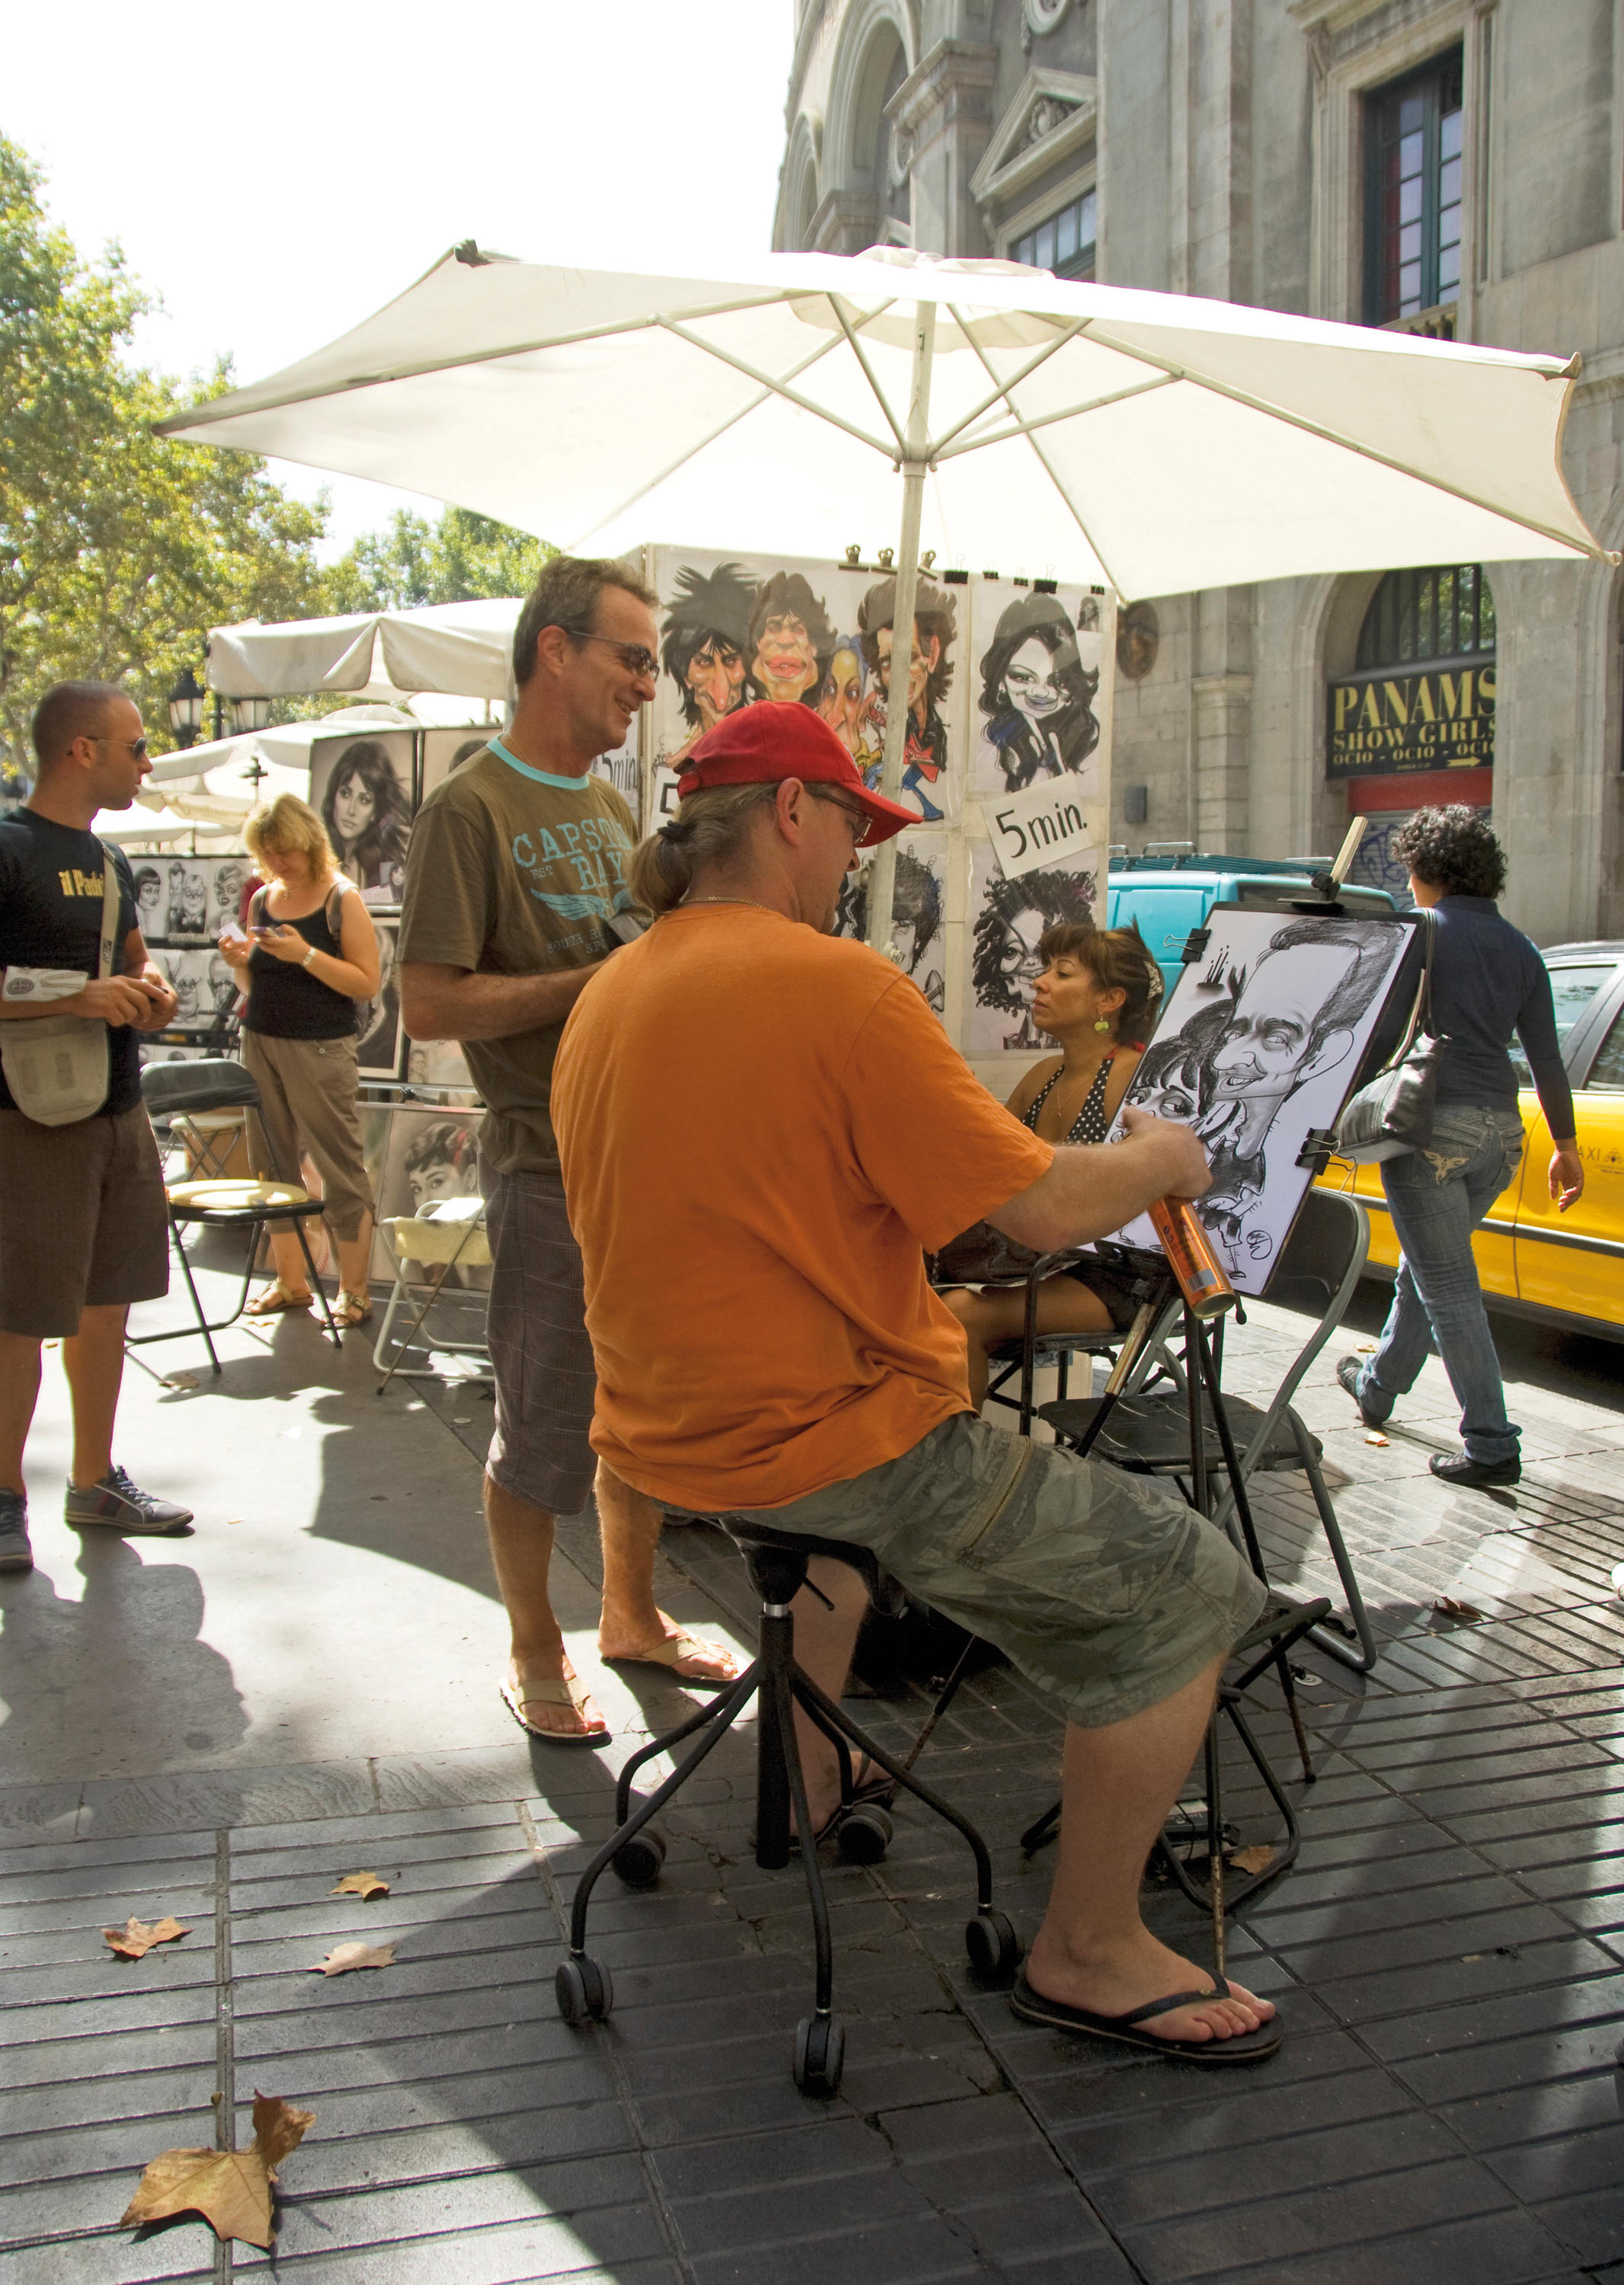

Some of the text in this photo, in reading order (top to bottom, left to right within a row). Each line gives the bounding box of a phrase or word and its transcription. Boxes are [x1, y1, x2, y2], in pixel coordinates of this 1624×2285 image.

[1334, 727, 1408, 751] SHOW
[1334, 751, 1373, 765] OCIO
[1392, 746, 1435, 760] OCIO
[58, 870, 75, 896] il
[570, 852, 627, 890] BAY
[1578, 1146, 1600, 1161] AXI
